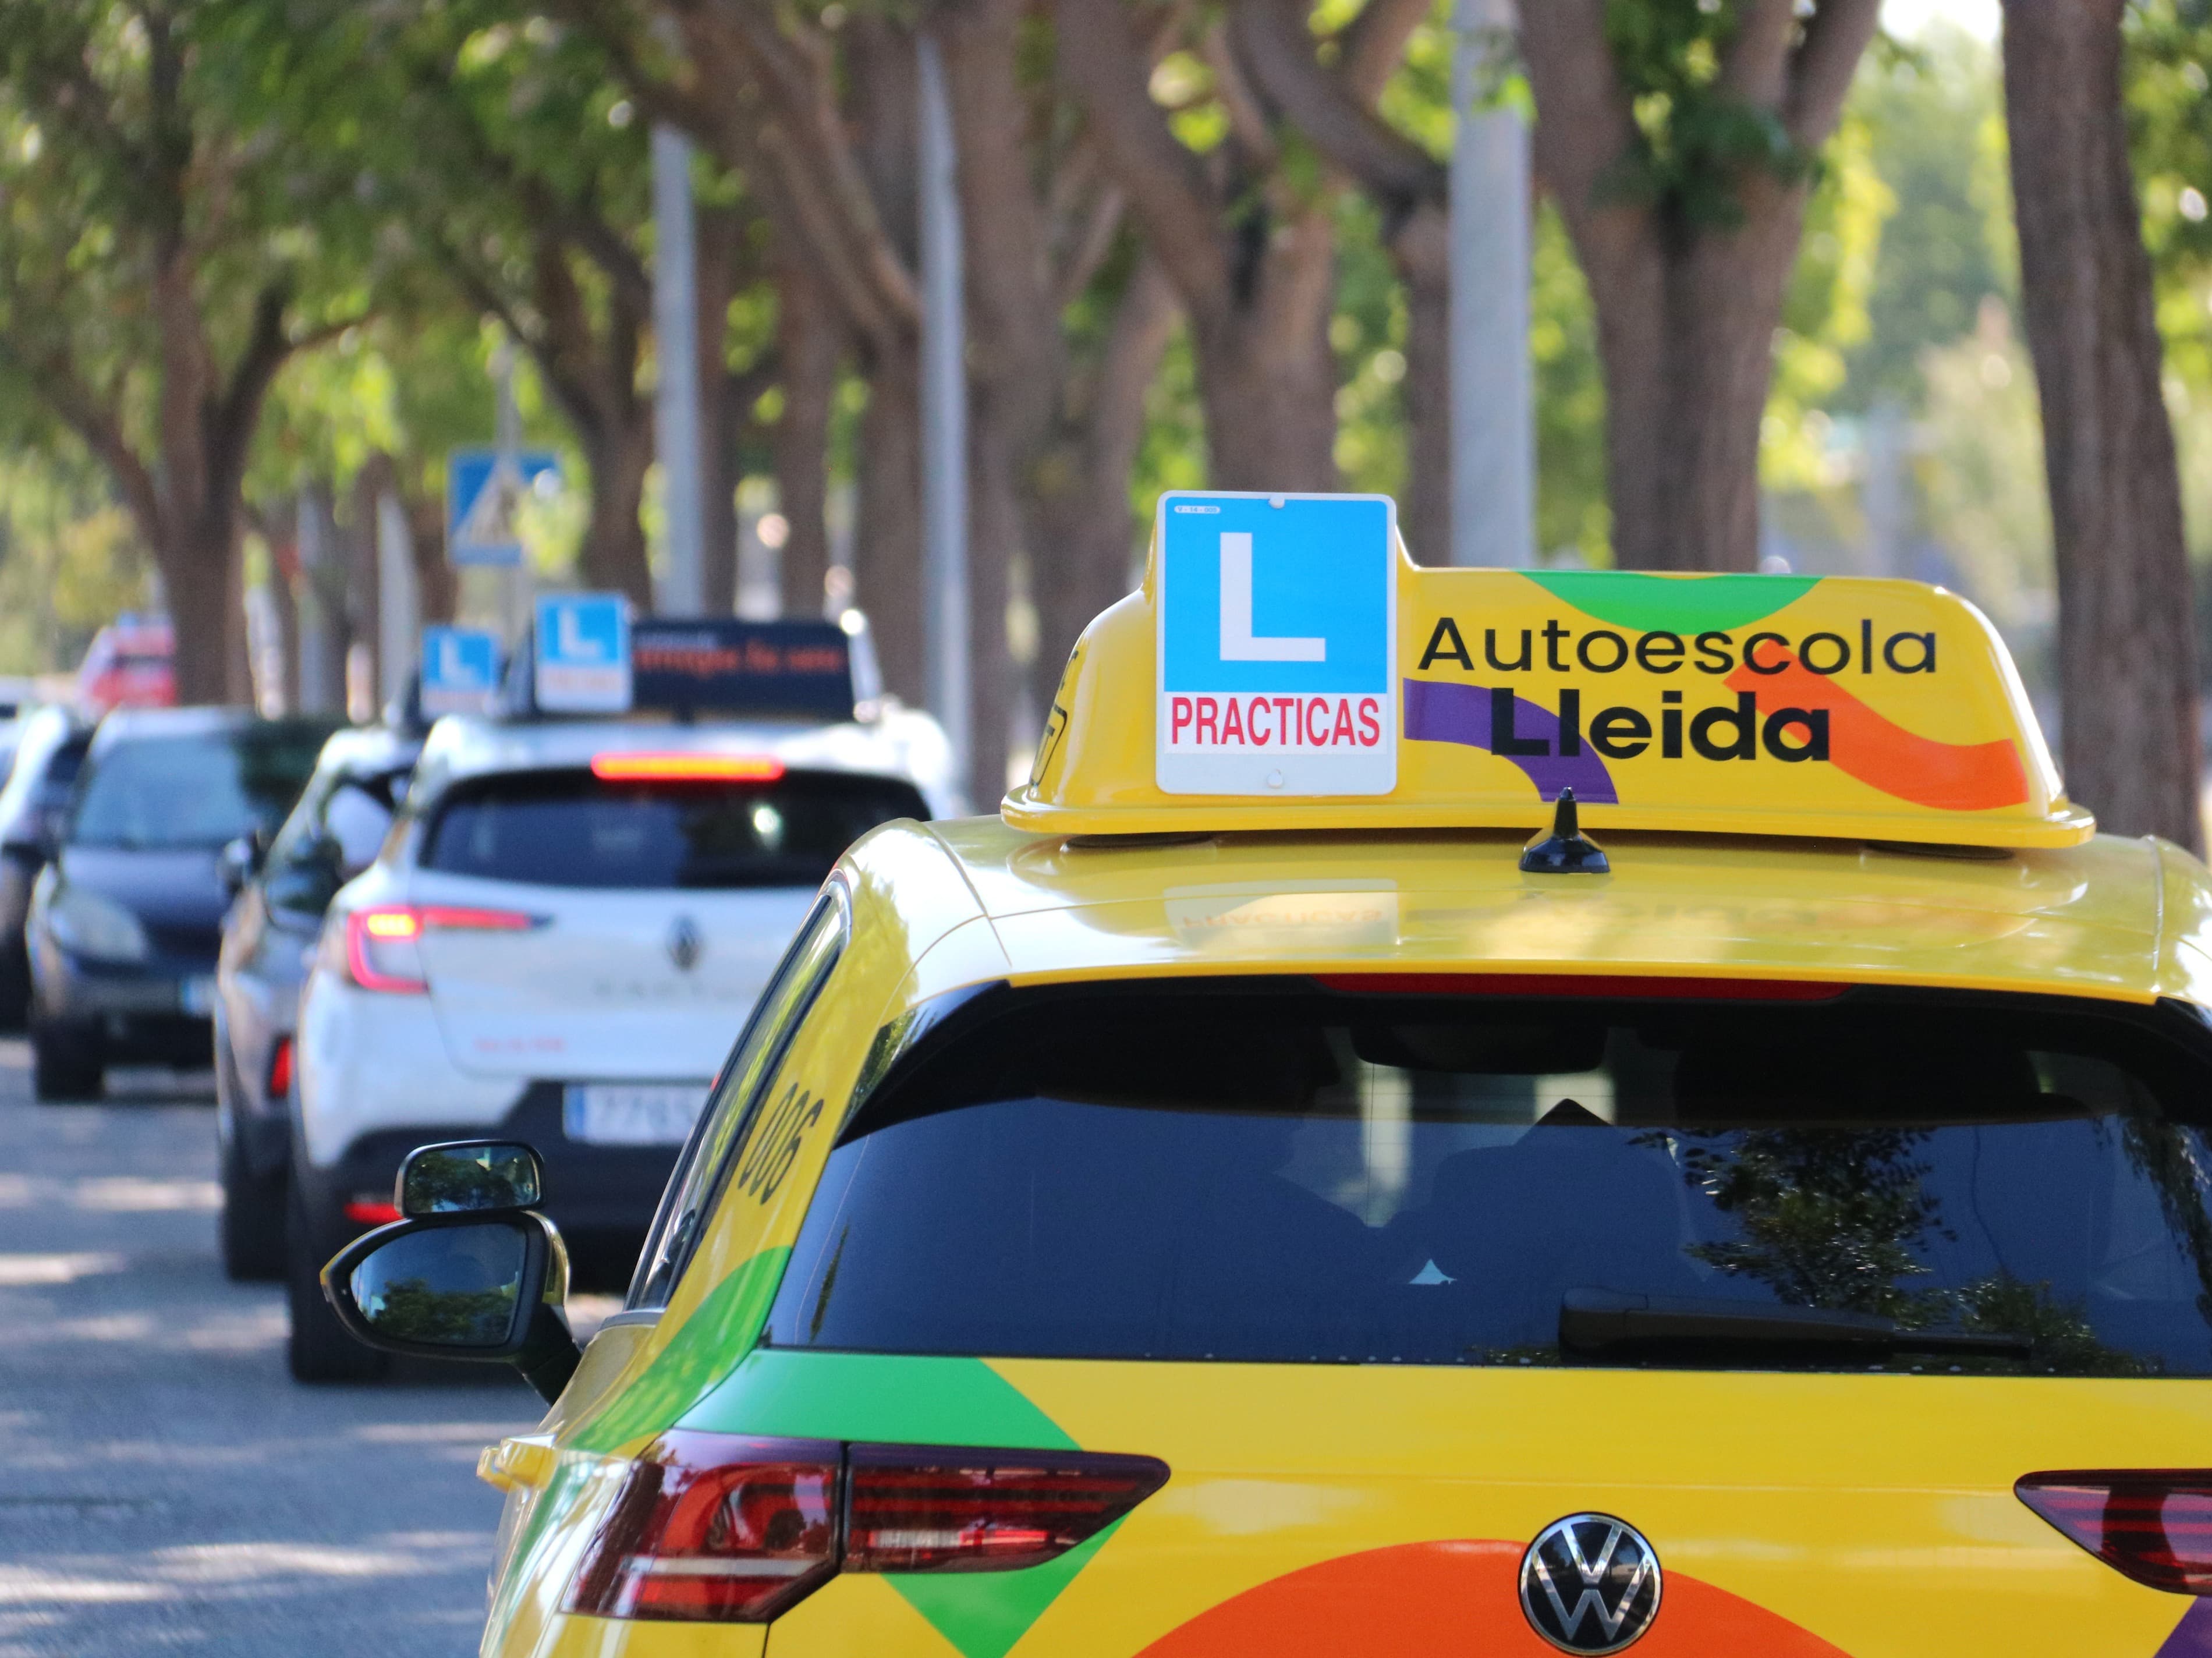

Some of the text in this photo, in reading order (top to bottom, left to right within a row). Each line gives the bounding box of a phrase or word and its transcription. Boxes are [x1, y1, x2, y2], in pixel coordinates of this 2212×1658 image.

[1220, 532, 1325, 662] L
[557, 605, 604, 658] L
[1417, 617, 1936, 675] Autoescola
[1171, 697, 1380, 747] PRACTICAS
[1490, 688, 1830, 763] Lleida
[738, 1082, 824, 1205] 006
